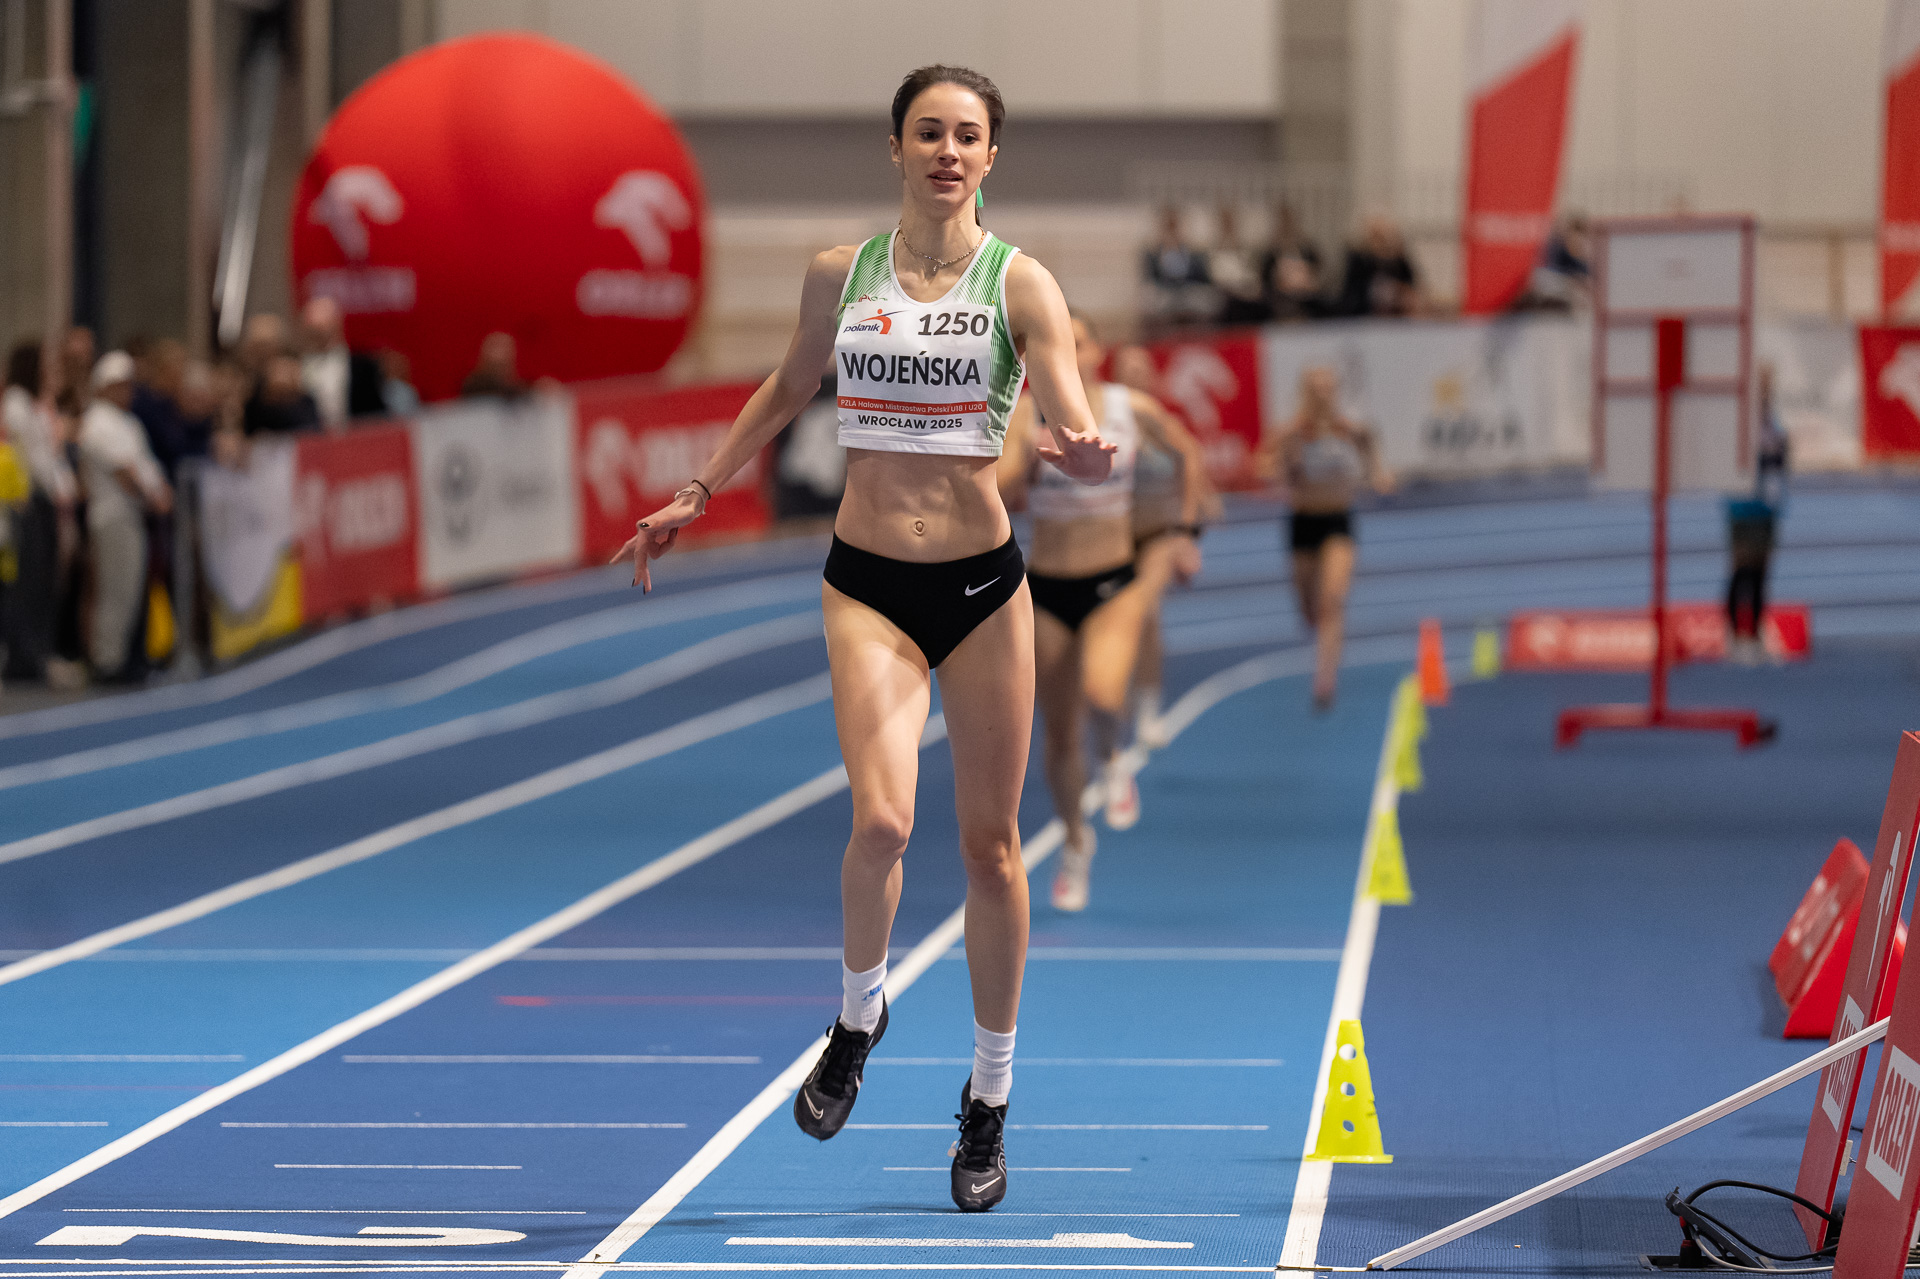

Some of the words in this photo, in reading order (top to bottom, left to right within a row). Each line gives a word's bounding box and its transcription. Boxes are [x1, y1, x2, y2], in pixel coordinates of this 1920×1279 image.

[843, 323, 880, 334] polanik
[917, 311, 989, 337] 1250
[840, 350, 982, 387] WOJEŃSKA
[840, 399, 857, 408] PZLA
[858, 400, 884, 410] Halowe
[885, 403, 926, 413] Mistrzostwa
[927, 405, 950, 414] Polski
[951, 404, 964, 413] U18
[968, 403, 983, 412] U20
[857, 414, 927, 430] WROCŁAW
[930, 417, 963, 430] 2025
[1872, 1066, 1920, 1177] ORLEN
